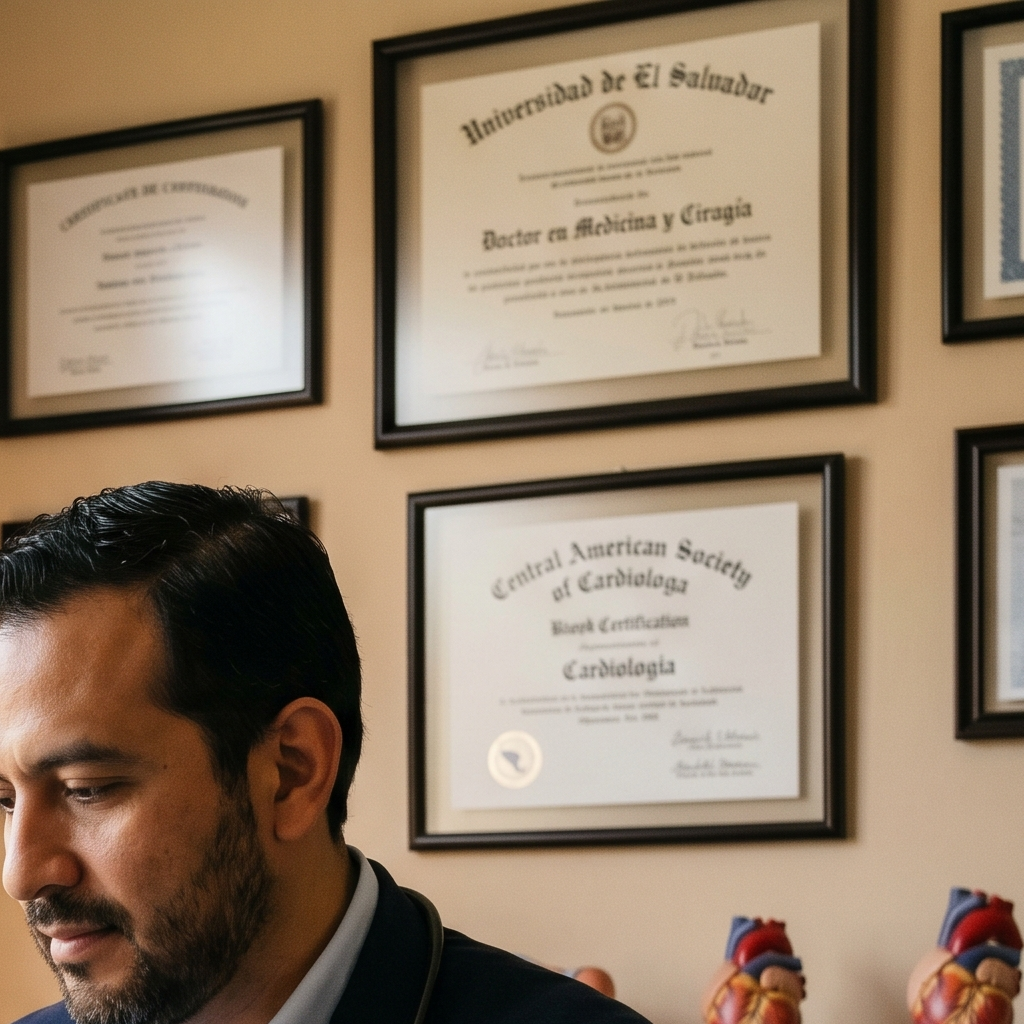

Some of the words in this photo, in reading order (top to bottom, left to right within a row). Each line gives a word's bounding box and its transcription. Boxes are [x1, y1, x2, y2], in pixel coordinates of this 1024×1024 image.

[600, 69, 626, 94] de
[669, 61, 774, 105] Salvador
[662, 211, 676, 234] y
[490, 547, 563, 600] Central
[568, 534, 667, 566] American
[675, 537, 752, 591] Society
[551, 577, 572, 603] of
